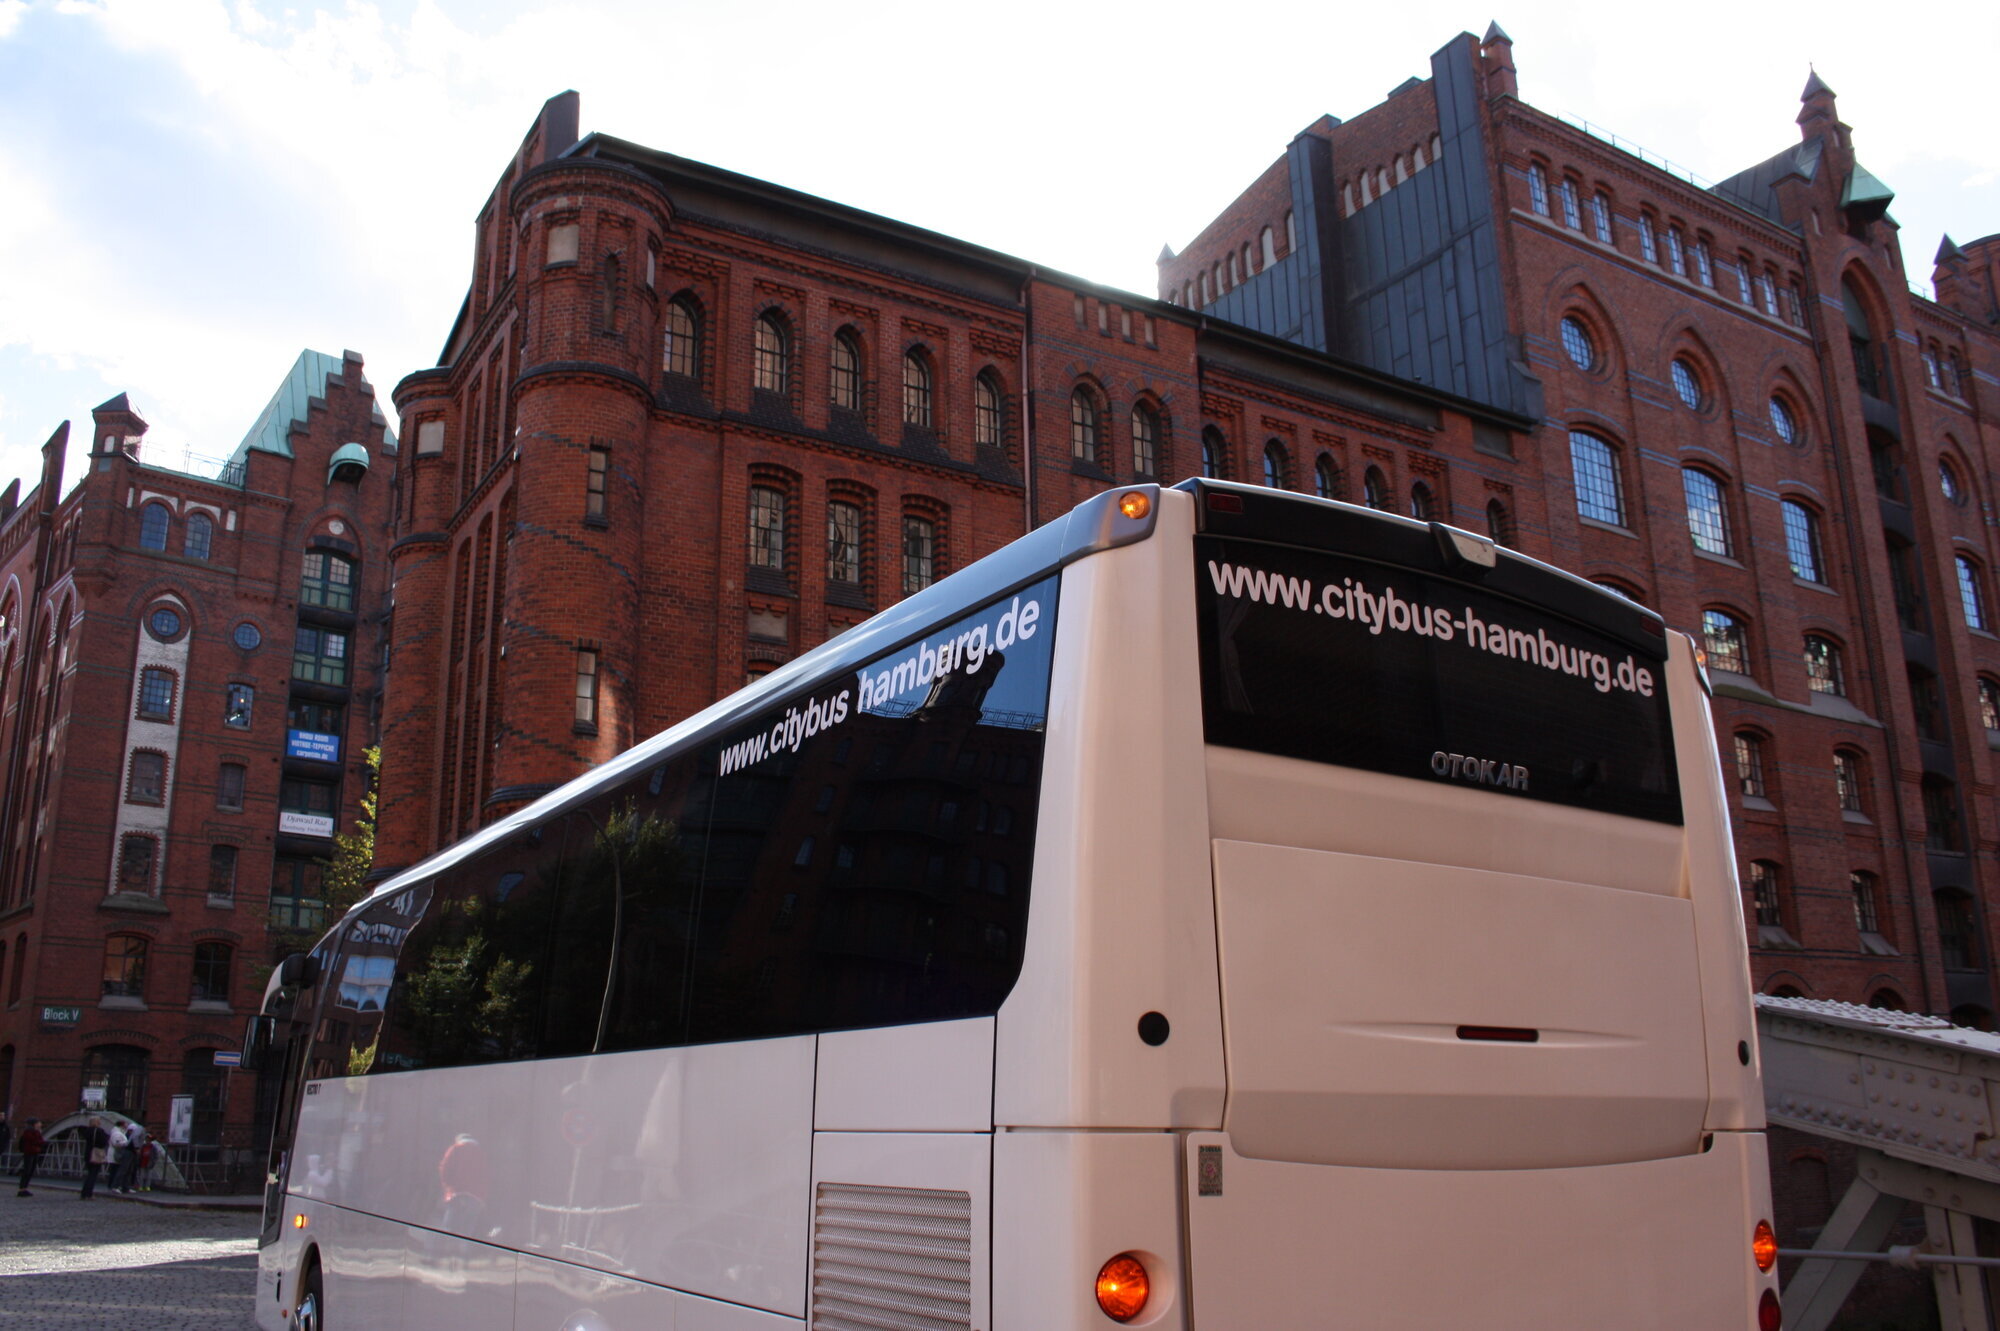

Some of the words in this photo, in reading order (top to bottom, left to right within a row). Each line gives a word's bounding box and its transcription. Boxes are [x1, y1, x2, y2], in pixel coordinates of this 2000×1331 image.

[1207, 560, 1654, 697] www.citybus-hamburg.de
[719, 688, 850, 777] www.citybus
[856, 596, 1040, 714] hamburg.de
[1430, 750, 1530, 791] OTOKAR
[44, 1008, 70, 1020] Block
[72, 1009, 80, 1021] V
